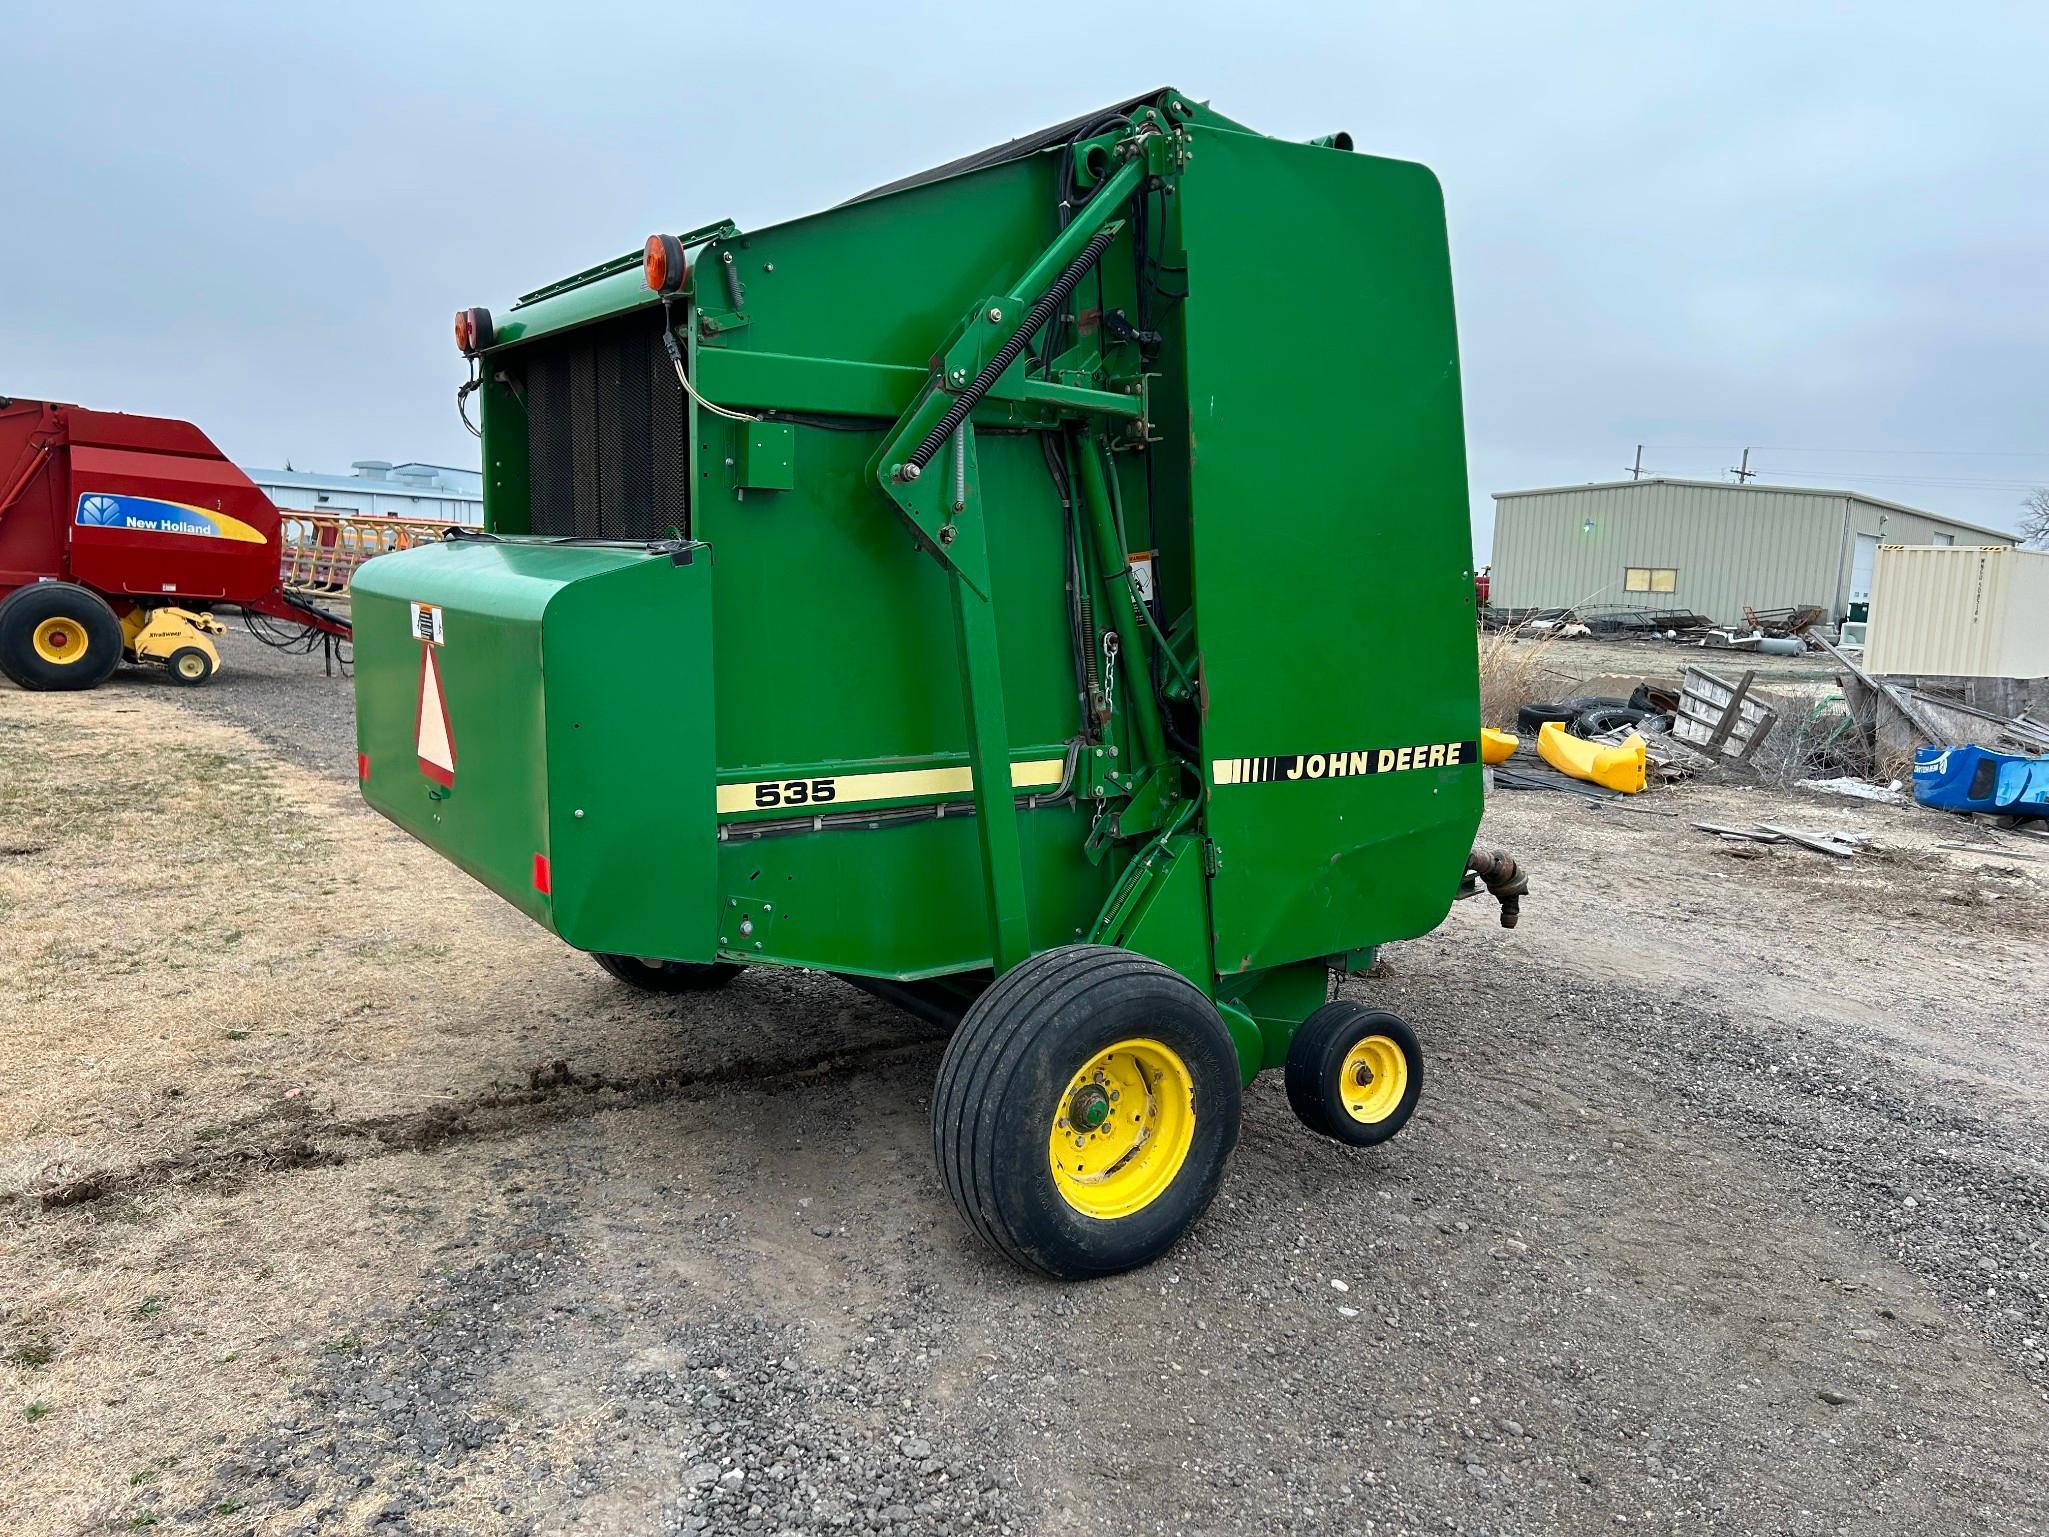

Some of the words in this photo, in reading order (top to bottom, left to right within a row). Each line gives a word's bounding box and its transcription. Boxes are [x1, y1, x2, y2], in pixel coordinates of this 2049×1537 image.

[126, 516, 157, 530] New
[161, 519, 211, 535] Holland
[1287, 751, 1368, 780] JOHN
[1377, 742, 1462, 773] DEERE
[755, 779, 836, 807] 535
